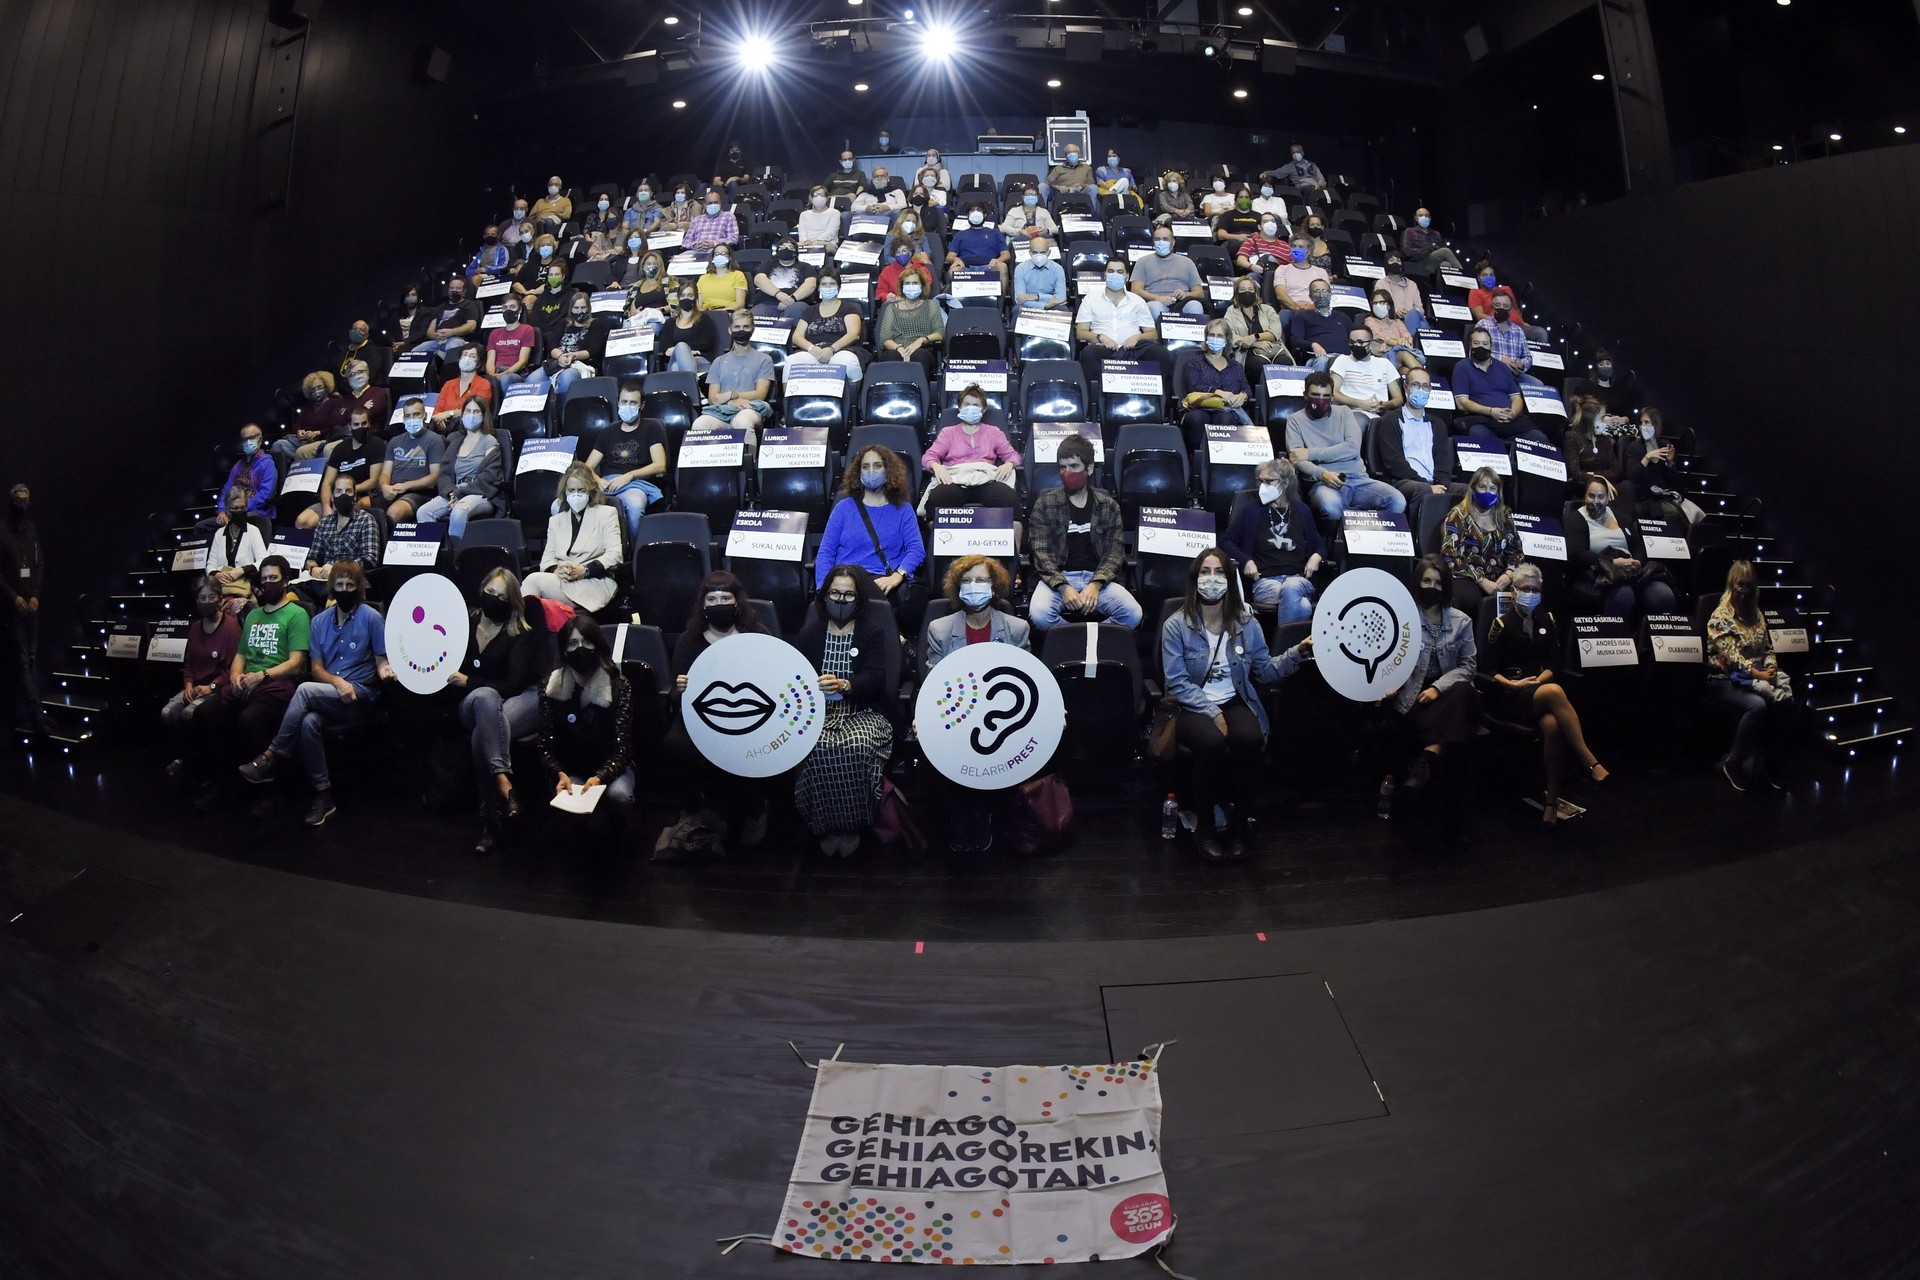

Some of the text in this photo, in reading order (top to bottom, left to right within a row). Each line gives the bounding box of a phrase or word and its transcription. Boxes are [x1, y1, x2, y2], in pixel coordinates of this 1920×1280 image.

[1208, 424, 1238, 432] GETXOKO
[684, 434, 733, 442] KOMUNIKAZIOA
[1538, 442, 1556, 452] KULTUR
[1543, 464, 1564, 474] EGOITZA
[938, 508, 975, 516] GETXOKO
[1152, 508, 1178, 516] MONA
[938, 516, 973, 524] EH BILDU
[1142, 516, 1177, 524] TABERNA
[1177, 532, 1210, 540] LABORAL
[1544, 536, 1562, 544] AMETS
[751, 542, 798, 552] SUKAL NOVA
[1186, 541, 1210, 550] KUTXA
[1532, 543, 1564, 552] KAMISETAK
[1647, 614, 1669, 622] BIZARRA
[1381, 621, 1411, 679] ARIGUNEA
[1616, 648, 1633, 656] ESKOLA
[1668, 646, 1700, 654] OLABARRIETA
[745, 730, 792, 759] AHOBIZI
[960, 736, 1038, 777] BELARRIPREST
[830, 1112, 1029, 1142] GEHIAGO,
[825, 1130, 1158, 1164] GEHIAGOREKIN,
[820, 1162, 1120, 1188] GEHIAGOTAN.
[1122, 1204, 1164, 1225] 365
[1128, 1220, 1162, 1233] EGUN
